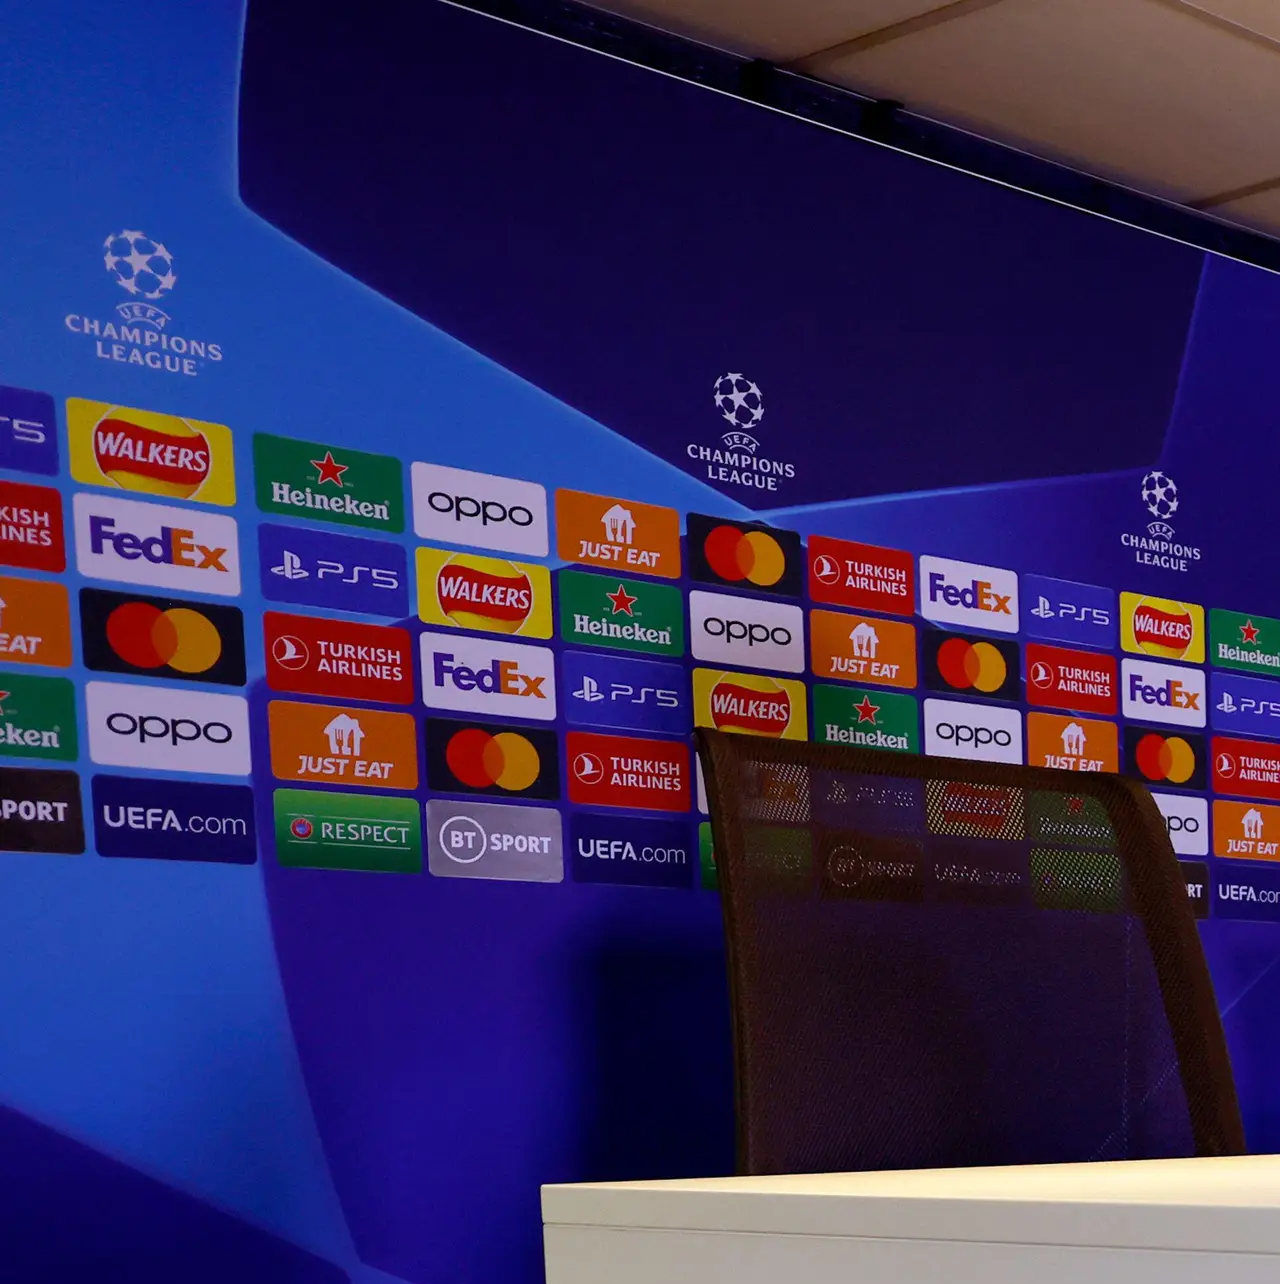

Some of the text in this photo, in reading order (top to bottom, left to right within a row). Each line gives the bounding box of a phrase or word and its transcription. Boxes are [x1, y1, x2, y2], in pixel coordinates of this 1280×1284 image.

[119, 305, 168, 328] UEFA
[64, 314, 223, 361] CHAMPIONS
[96, 341, 197, 376] LEAGUE
[98, 431, 207, 472] WALKERS
[724, 435, 757, 452] UEFA
[687, 444, 795, 478] CHAMPIONS
[708, 465, 777, 491] LEAGUE
[271, 482, 390, 520] Heineken
[428, 492, 533, 526] oppo
[0, 525, 52, 546] INES
[90, 515, 229, 572] FedEx
[1148, 523, 1173, 539] UEFA
[578, 540, 660, 568] JUST EAT
[1121, 533, 1200, 560] CHAMPIONS
[845, 559, 906, 582] TURKISH
[1136, 551, 1187, 571] LEAGUE
[317, 560, 398, 590] PS5
[846, 576, 907, 596] AIRLINES
[440, 576, 530, 609] WALKERS
[929, 571, 1012, 616] FedEx
[1059, 603, 1110, 626] PS5
[1135, 613, 1191, 640] WALKERS
[574, 614, 671, 645] Heineken
[703, 617, 792, 646] oppo
[317, 640, 401, 665] TURKISH
[1218, 643, 1280, 667] Heineken
[317, 658, 403, 681] AIRLINES
[433, 651, 546, 699] FedEx
[830, 656, 899, 679] JUST EAT
[1058, 665, 1110, 684] TURKISH
[610, 683, 679, 708] PS5
[1057, 680, 1111, 698] AIRLINES
[1129, 674, 1200, 710] FedEx
[713, 693, 788, 722] WALKERS
[107, 713, 232, 745] oppo
[825, 723, 908, 750] Heineken
[936, 722, 1011, 749] oppo
[297, 755, 394, 779] JUST EAT
[610, 757, 680, 776] TURKISH
[1044, 754, 1104, 772] JUST EAT
[610, 772, 681, 791] AIRLINES
[0, 799, 68, 821] PORT
[103, 805, 246, 835] UEFA.com
[321, 821, 410, 844] RESPECT
[450, 829, 551, 854] BT SPORT
[578, 838, 686, 864] UEFA.com
[1227, 840, 1279, 855] JUST EAT
